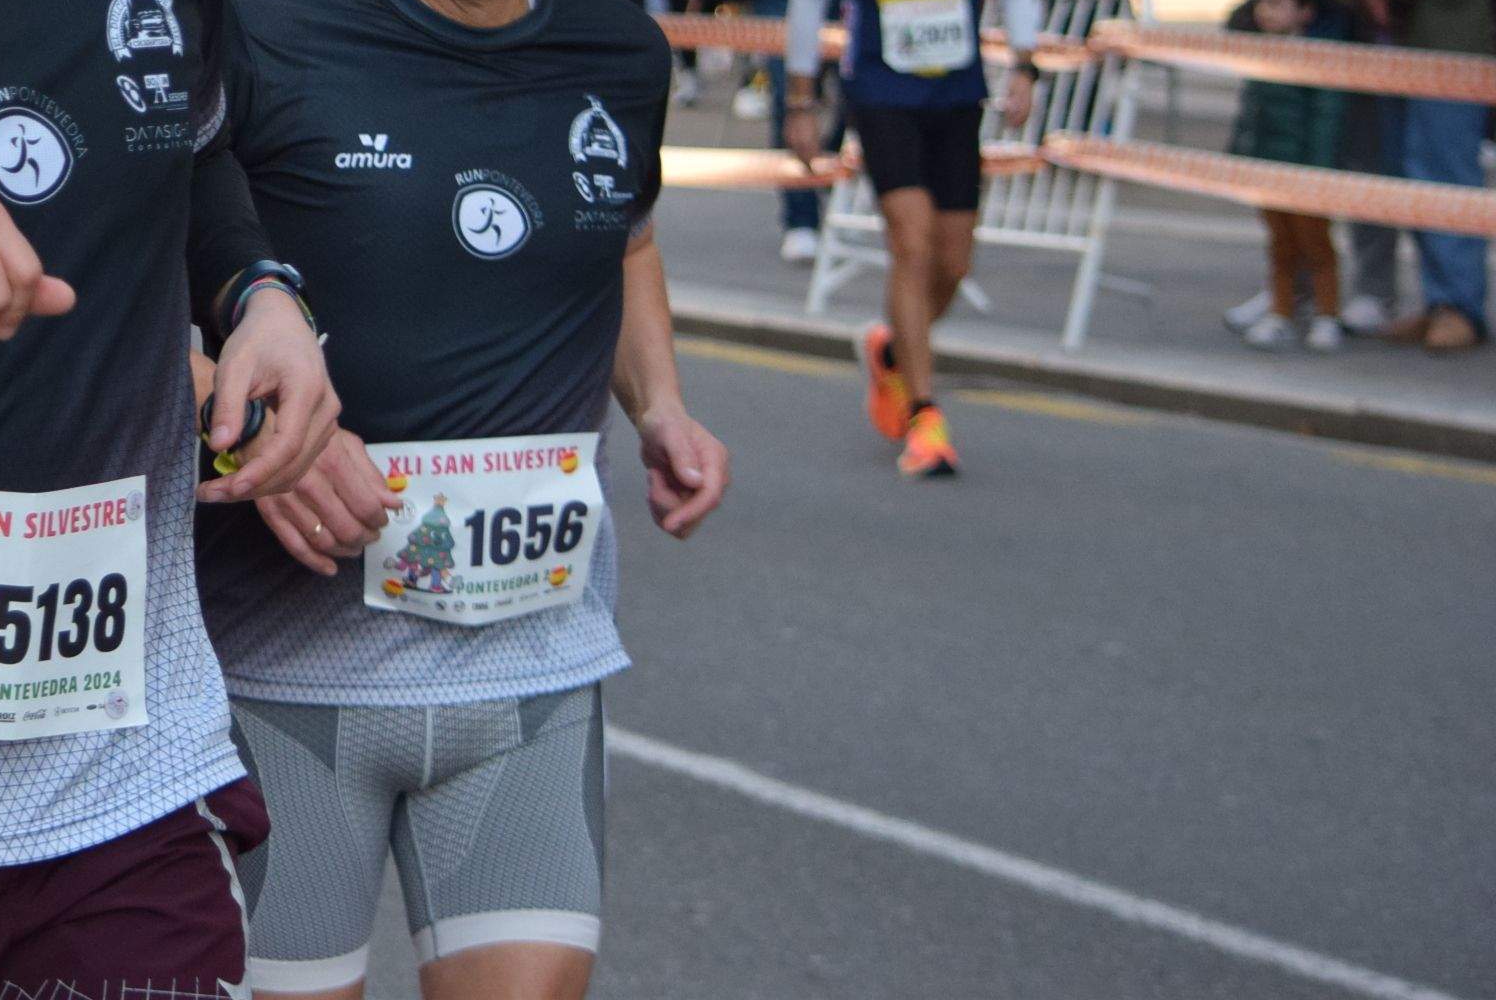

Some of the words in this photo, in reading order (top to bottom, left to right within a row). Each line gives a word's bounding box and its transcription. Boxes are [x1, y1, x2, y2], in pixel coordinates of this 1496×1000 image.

[334, 152, 412, 169] amura
[431, 453, 474, 476] SAN
[23, 498, 127, 539] SILVESTRE
[464, 500, 589, 567] 1656
[457, 573, 540, 595] PONTEVEDRA
[84, 670, 122, 692] 2024
